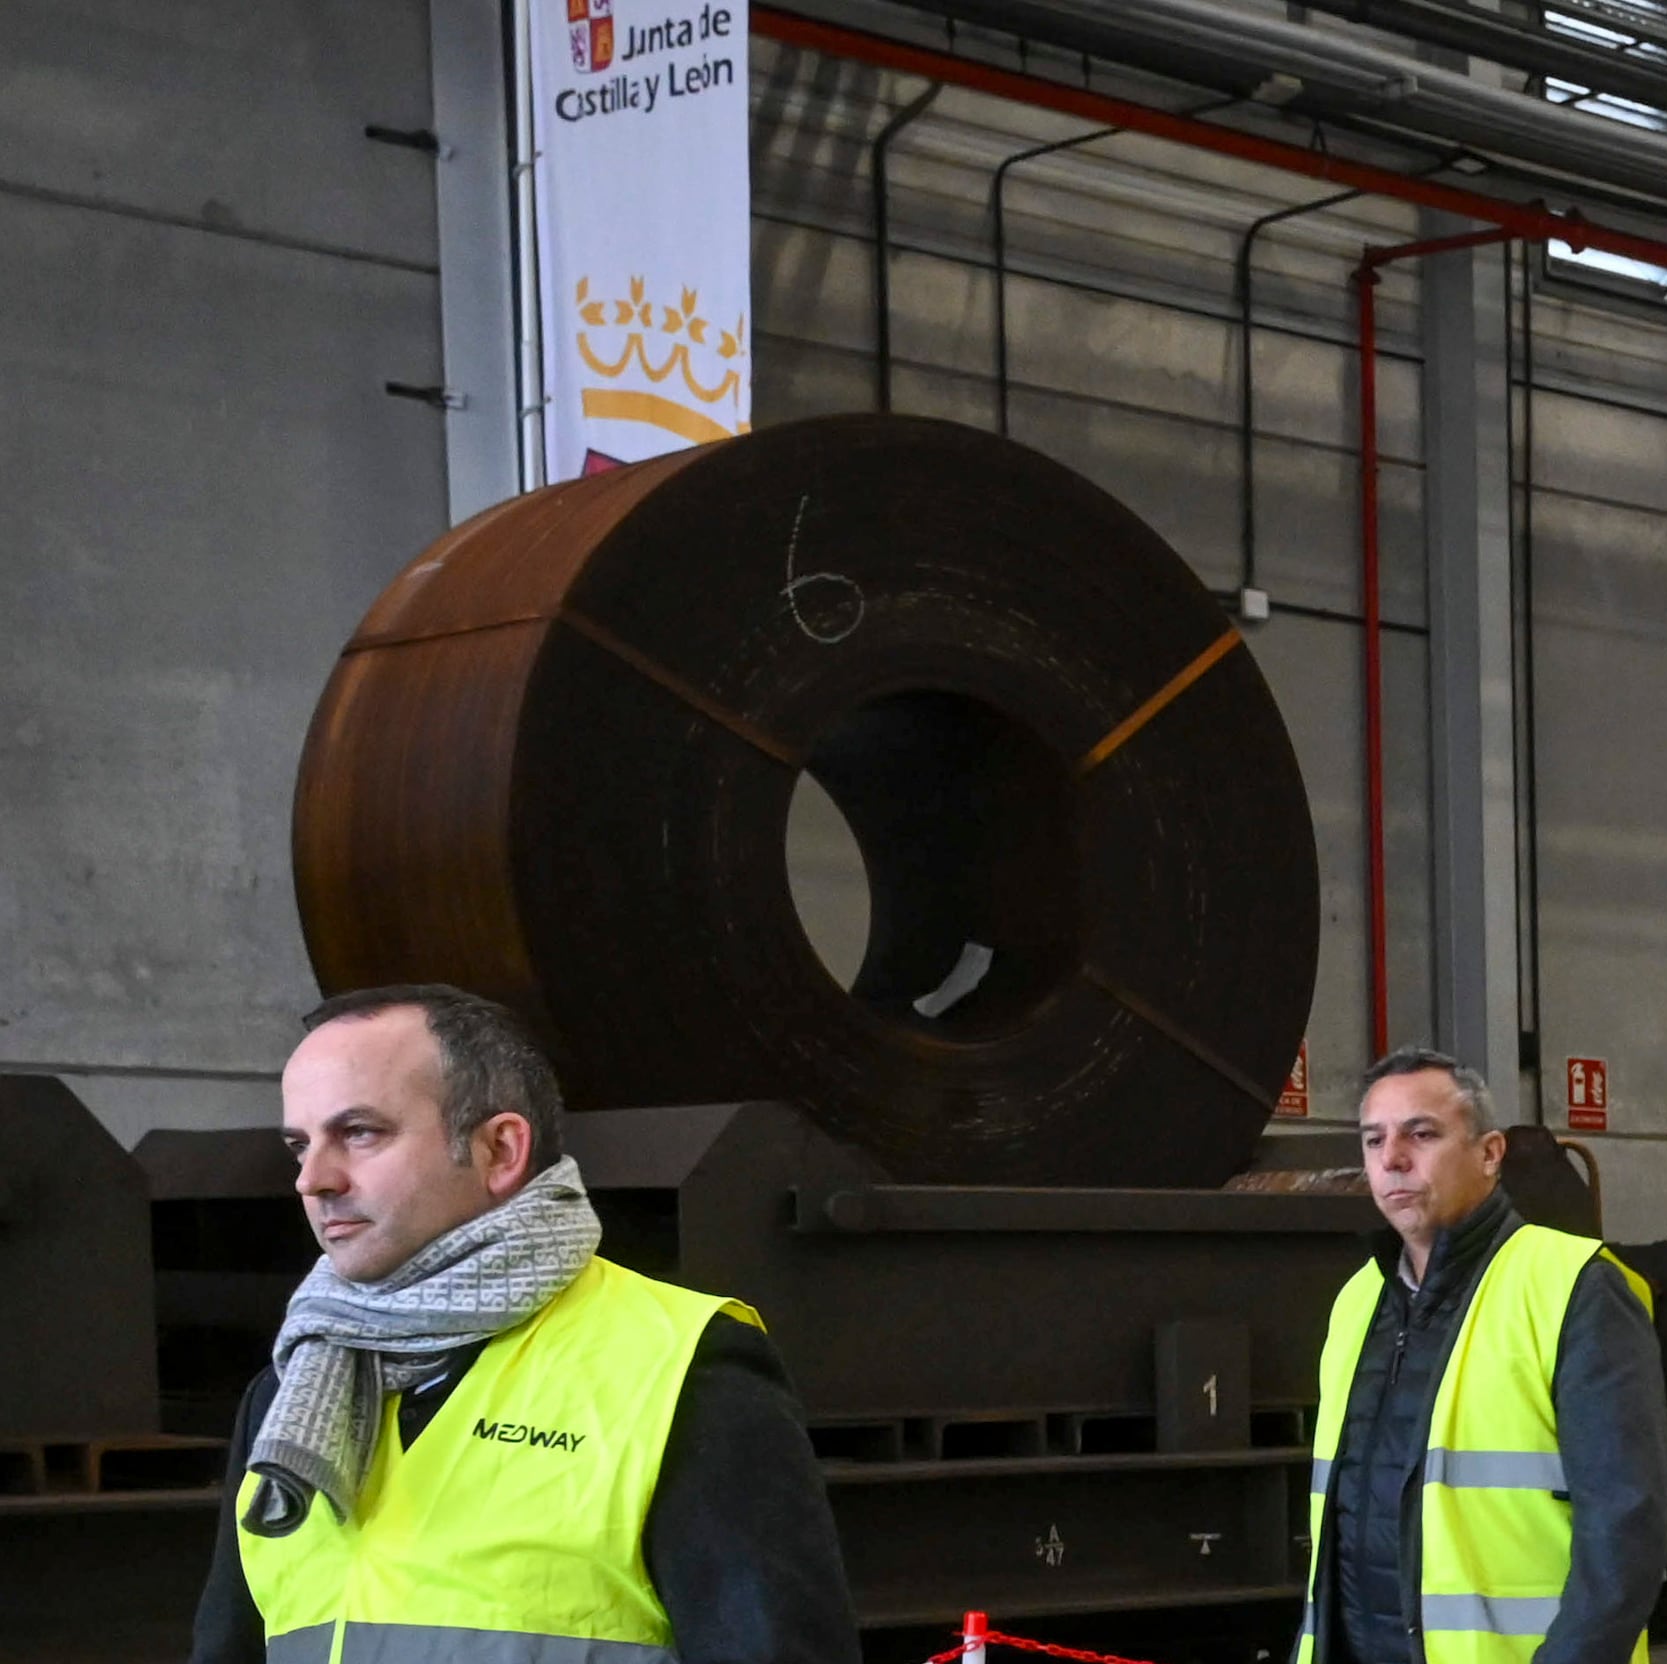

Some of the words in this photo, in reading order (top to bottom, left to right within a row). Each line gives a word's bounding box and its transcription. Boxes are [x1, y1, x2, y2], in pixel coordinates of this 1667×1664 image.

[622, 17, 692, 61] Junta
[699, 3, 732, 41] de
[645, 74, 660, 113] y
[669, 54, 733, 97] León
[1203, 1375, 1217, 1416] 1
[472, 1418, 587, 1453] MEDWAY
